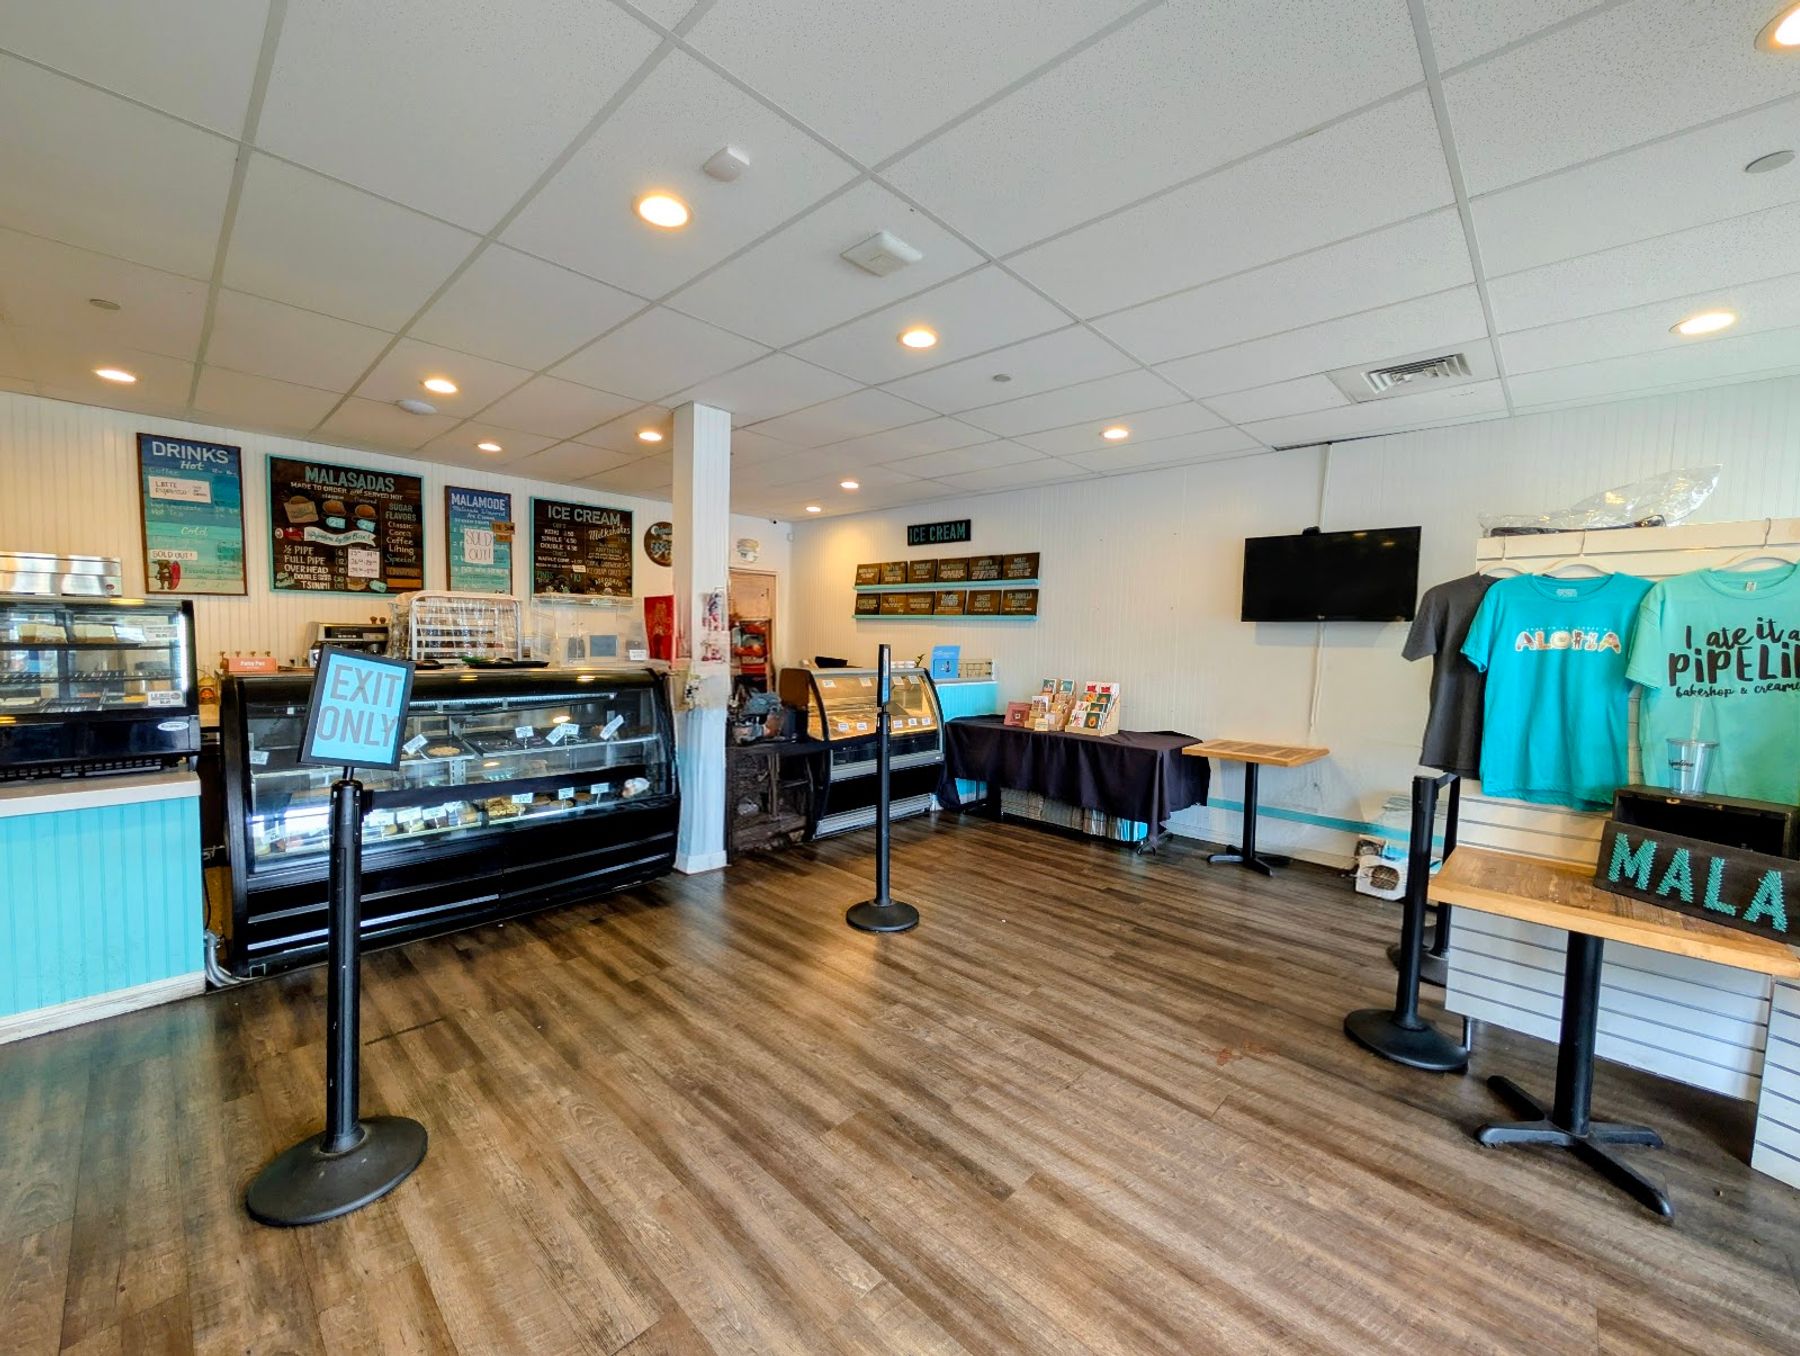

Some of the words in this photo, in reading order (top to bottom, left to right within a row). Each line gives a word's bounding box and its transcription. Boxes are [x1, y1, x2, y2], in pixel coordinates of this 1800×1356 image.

[151, 441, 229, 464] DRINKS
[180, 461, 205, 470] Hot
[304, 465, 395, 493] MALASADAS
[290, 482, 311, 490] MADE
[323, 486, 347, 494] ORDER
[363, 489, 390, 499] SERVED
[389, 503, 413, 513] SUGAR
[451, 493, 506, 511] MALAMODE
[385, 511, 417, 521] FLAVORS
[548, 505, 571, 520] ICE
[574, 509, 620, 526] CREAM
[387, 521, 413, 530] Classic
[909, 527, 926, 543] ICE
[930, 522, 966, 541] CREAM
[386, 536, 414, 545] Coffee
[152, 550, 173, 558] SOLD
[294, 545, 314, 555] PIPE
[284, 555, 304, 564] FULL
[307, 557, 326, 565] PIPE
[284, 564, 328, 573] OVERHEAD
[1515, 629, 1621, 654] ALOHA
[1685, 625, 1692, 649] I
[1706, 627, 1754, 650] ate
[1756, 617, 1784, 643] it
[330, 664, 402, 708] EXIT
[1675, 684, 1735, 698] bakeshop
[316, 705, 399, 747] ONLY
[1606, 832, 1788, 933] MALA
